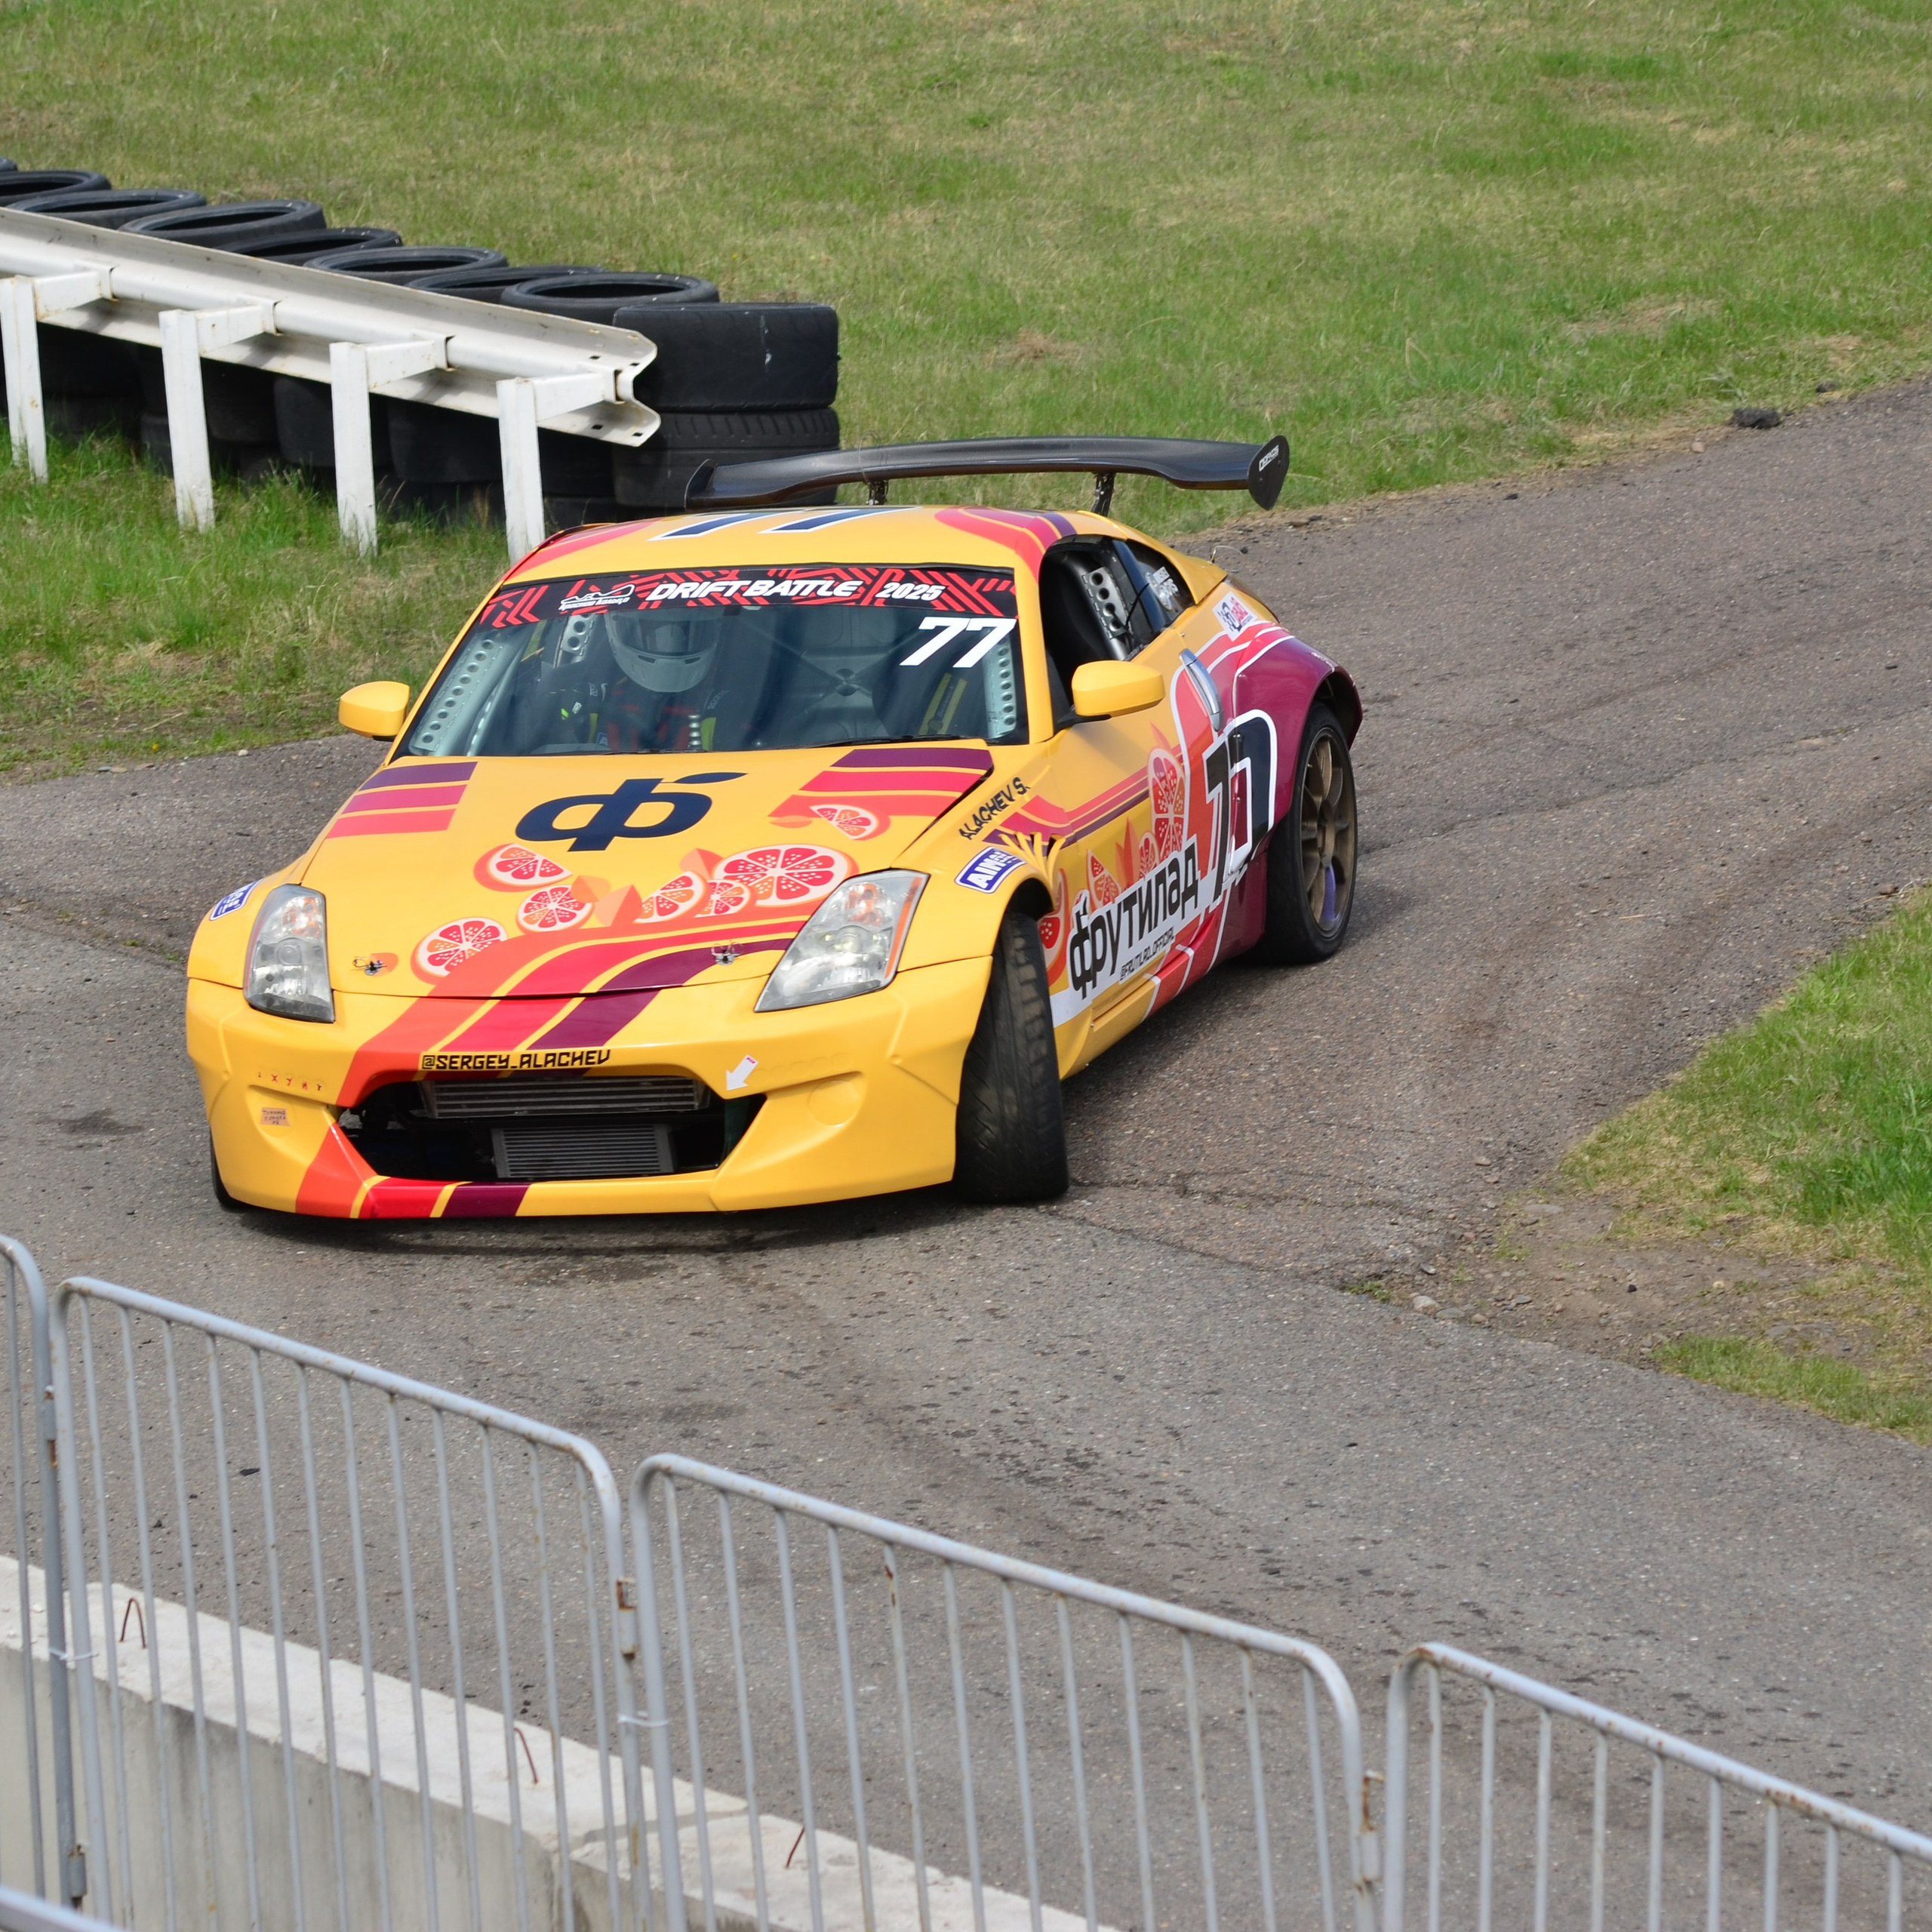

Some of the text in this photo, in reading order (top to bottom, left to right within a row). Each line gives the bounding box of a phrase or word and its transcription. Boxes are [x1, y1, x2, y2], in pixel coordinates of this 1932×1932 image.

[645, 580, 946, 601] DRIFT BATTLE 2025
[899, 617, 1017, 668] 77
[958, 784, 1016, 841] ALACHEV
[421, 1049, 611, 1071] @SERGEY_ALACHEV
